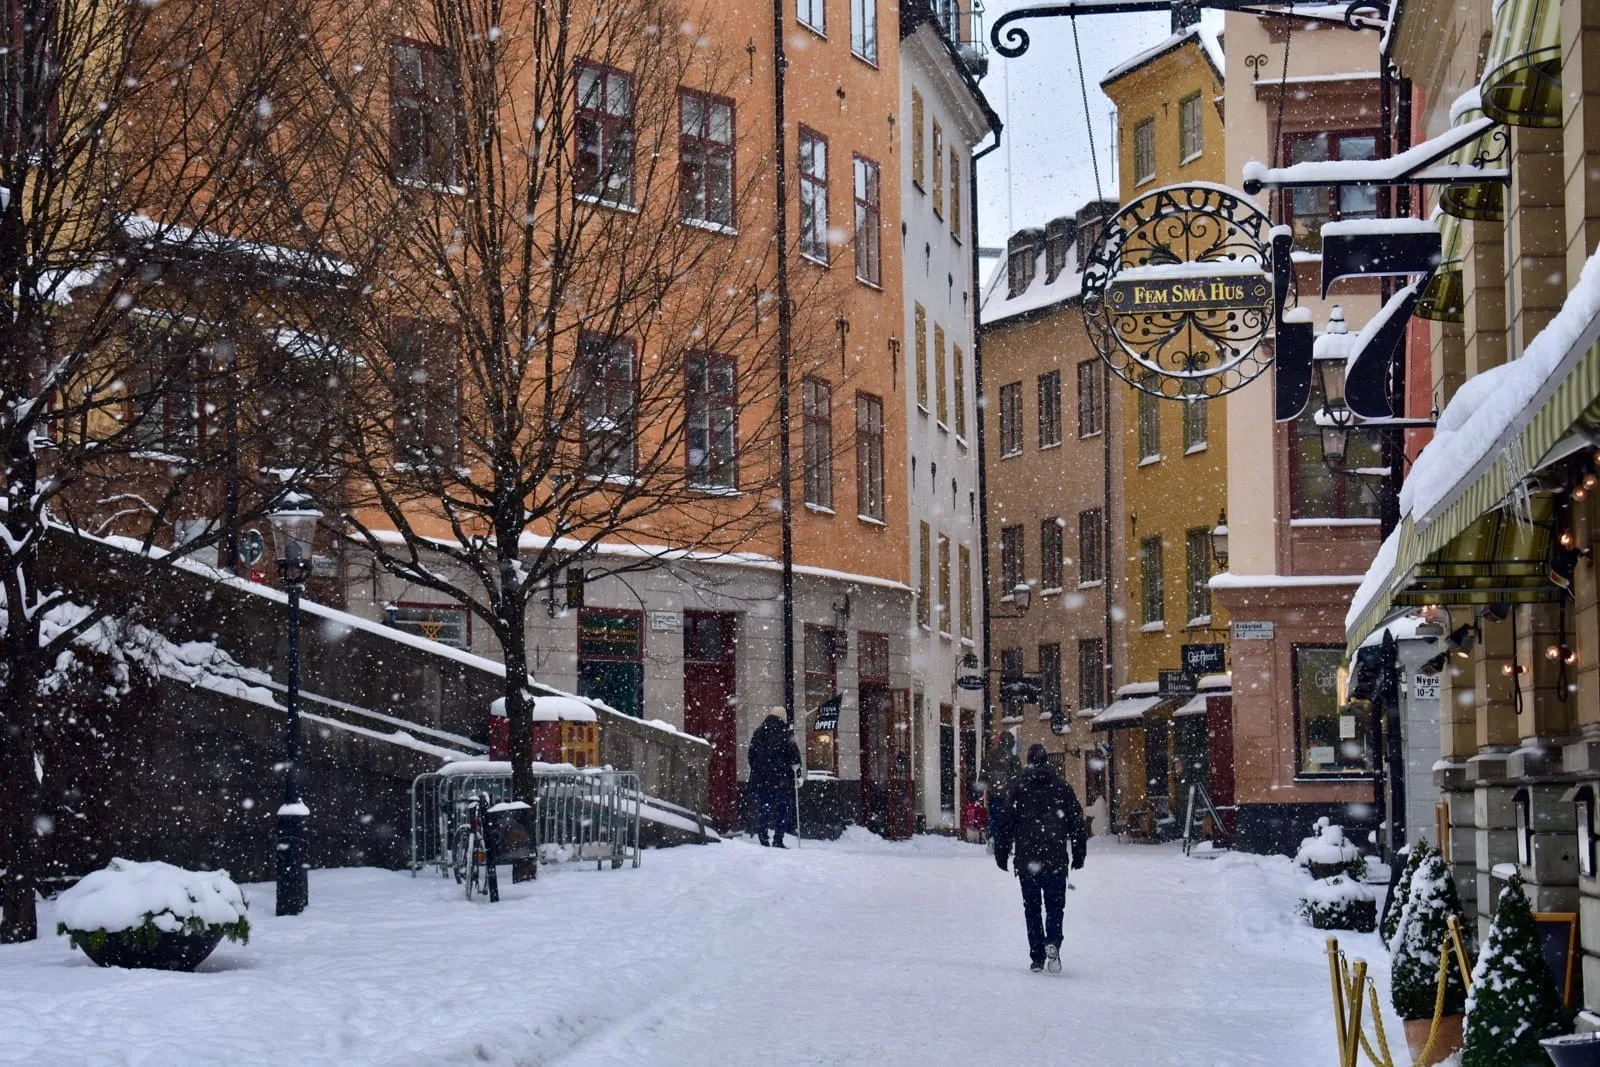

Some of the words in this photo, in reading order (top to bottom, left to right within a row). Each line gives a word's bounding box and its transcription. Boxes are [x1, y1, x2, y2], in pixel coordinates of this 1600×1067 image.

[1134, 286, 1168, 304] FEM
[1210, 283, 1244, 300] HUS
[1417, 688, 1434, 696] 10-2
